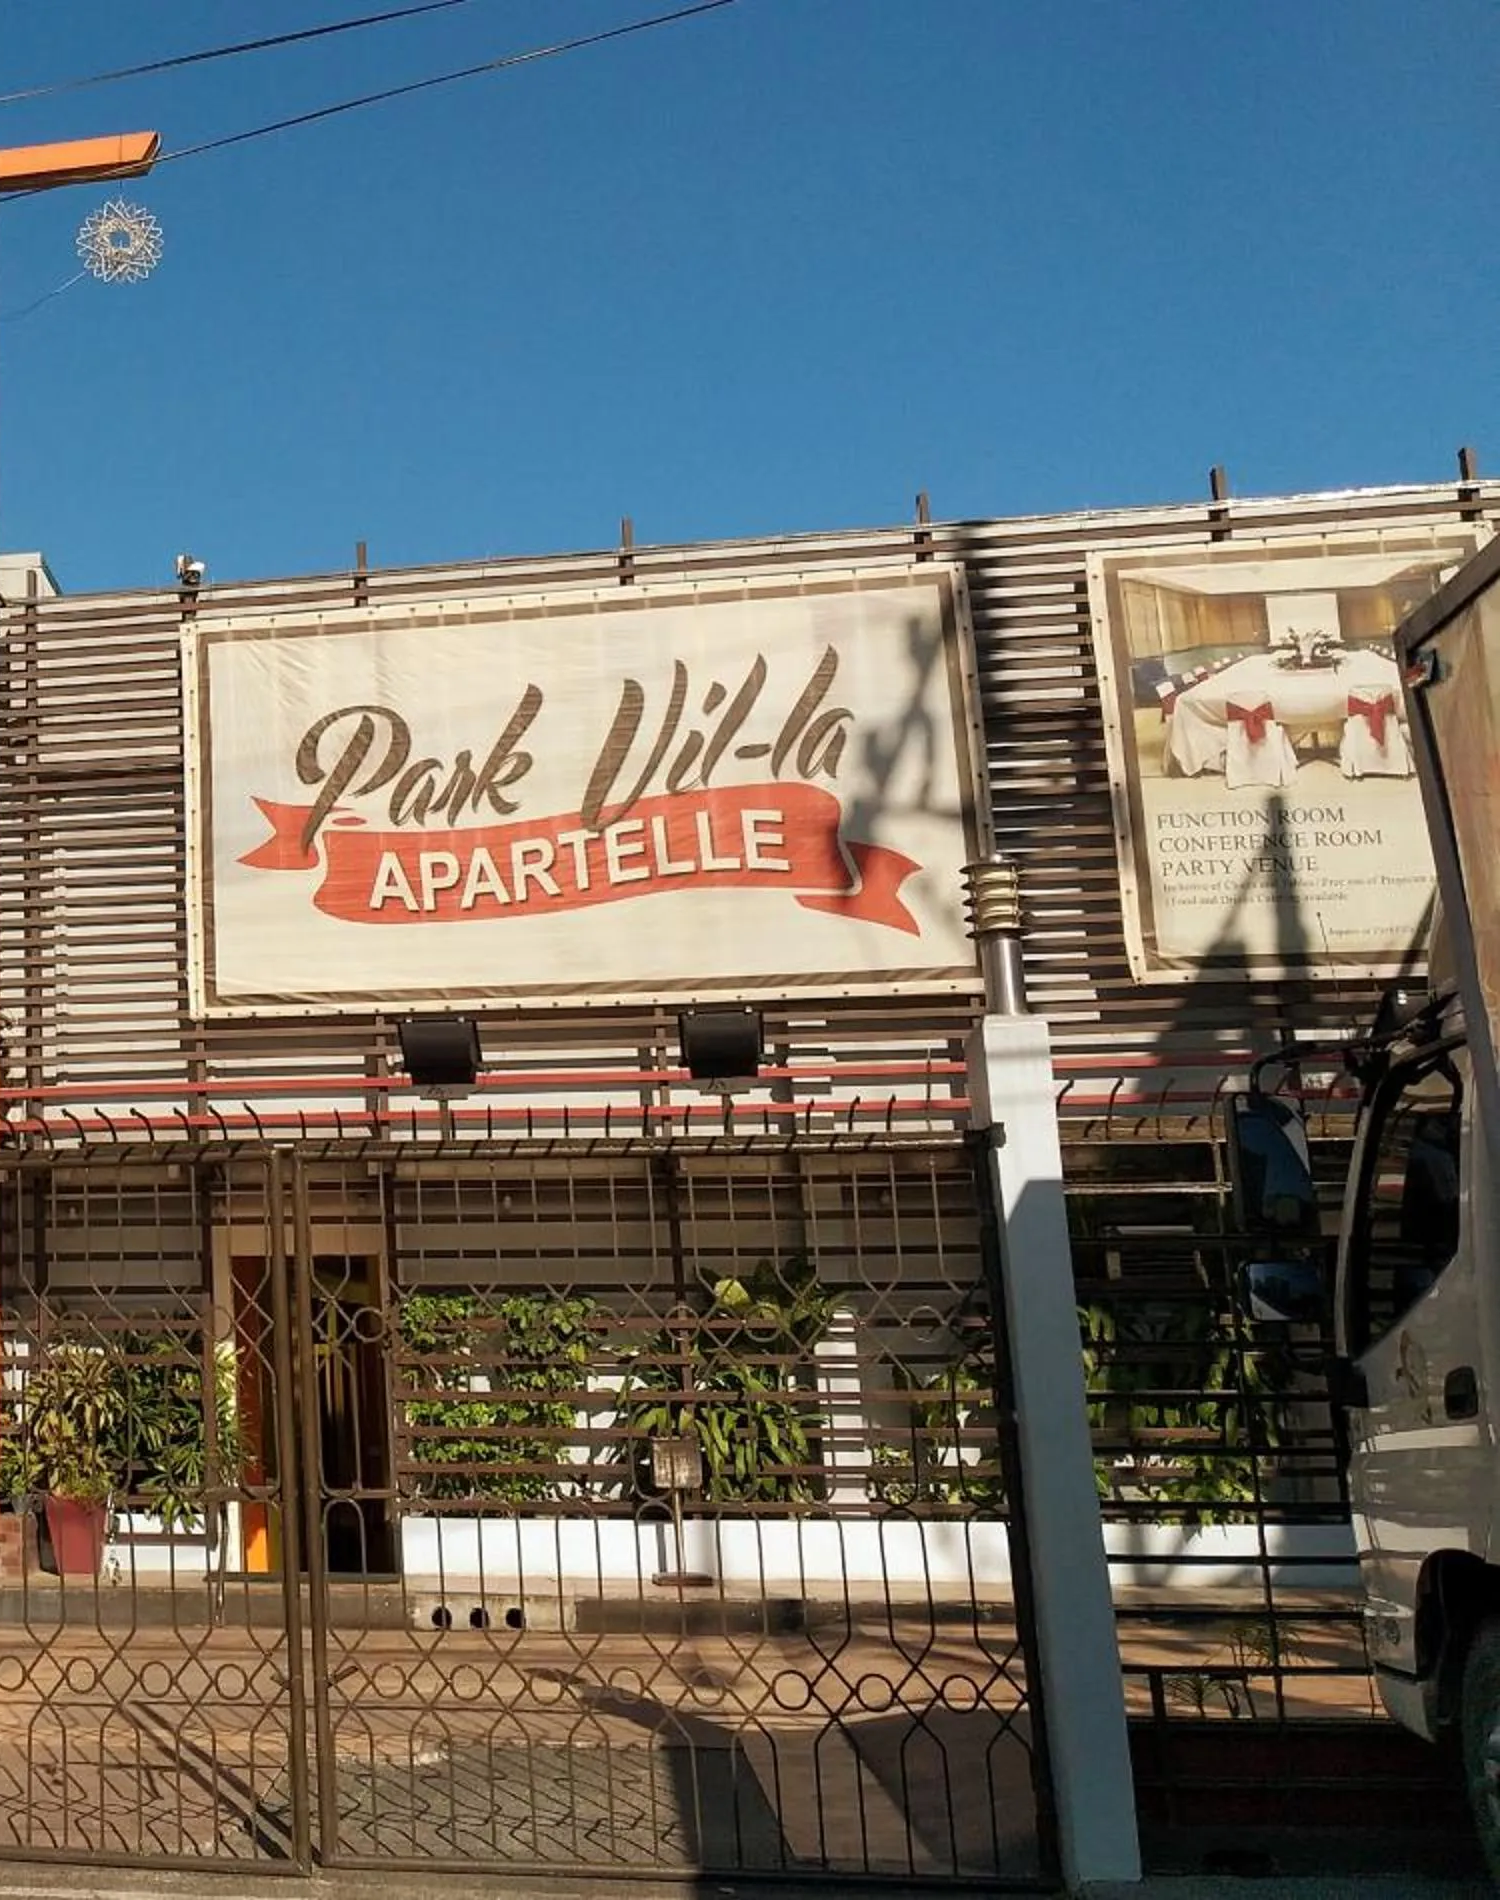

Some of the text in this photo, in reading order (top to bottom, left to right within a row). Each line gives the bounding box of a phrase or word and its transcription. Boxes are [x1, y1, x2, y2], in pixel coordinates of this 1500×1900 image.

[296, 683, 543, 855] Park
[1157, 807, 1345, 829] FUNCTION ROOM
[1160, 829, 1382, 853] CONFERENCE ROOM
[368, 808, 791, 912] APARTELLE
[1162, 856, 1317, 877] PARTY VENUE
